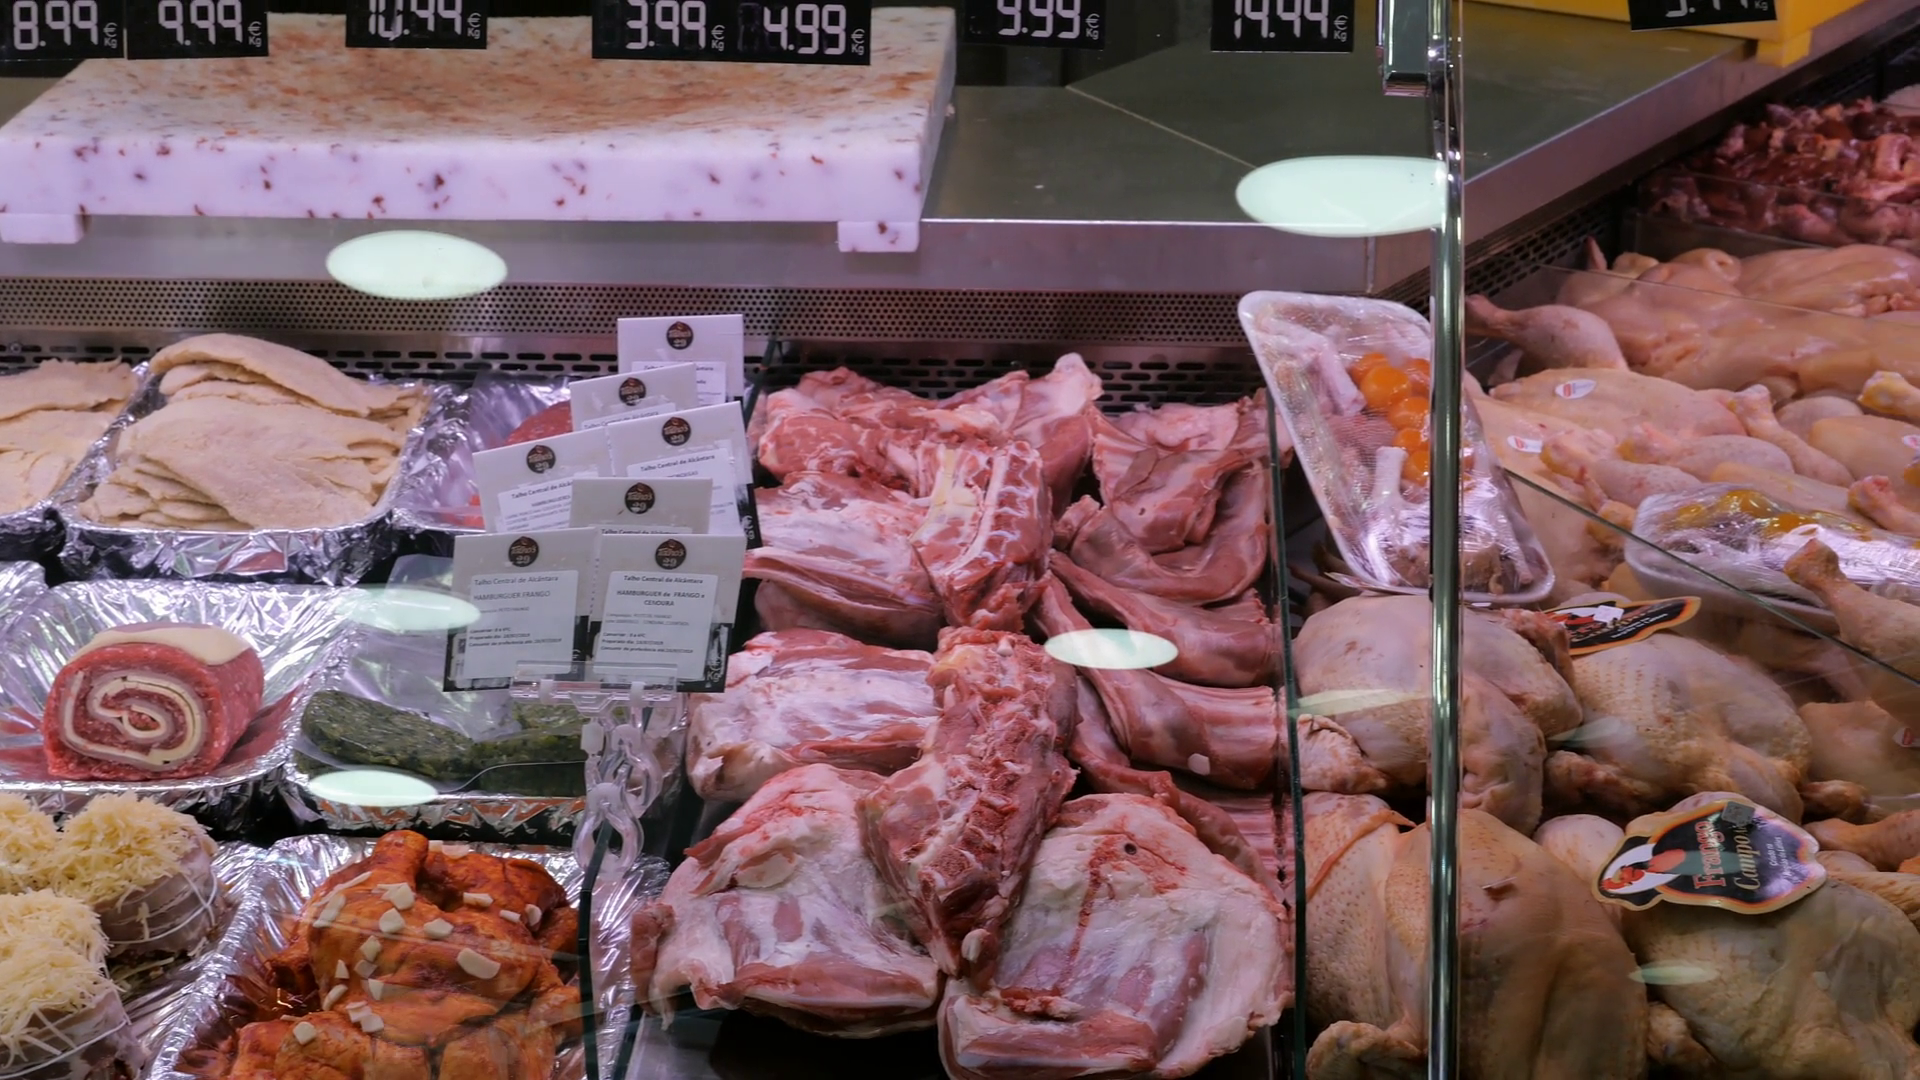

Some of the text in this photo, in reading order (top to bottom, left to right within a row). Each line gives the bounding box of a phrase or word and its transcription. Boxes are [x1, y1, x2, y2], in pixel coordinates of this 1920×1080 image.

[12, 0, 98, 50] 8.99
[158, 0, 243, 45] 9.99
[625, 0, 706, 49] 3.99
[763, 3, 846, 55] 4.99
[467, 27, 480, 39] Kg
[1085, 28, 1099, 40] Kg
[1333, 30, 1348, 42] Kg
[103, 37, 118, 49] Kg
[248, 35, 262, 48] Kg
[711, 39, 725, 52] Kg
[851, 43, 865, 56] Kg
[493, 577, 517, 585] Central
[641, 575, 665, 583] Central
[473, 590, 551, 601] HAMBURGUER FRANGO
[1692, 821, 1726, 889] Frango
